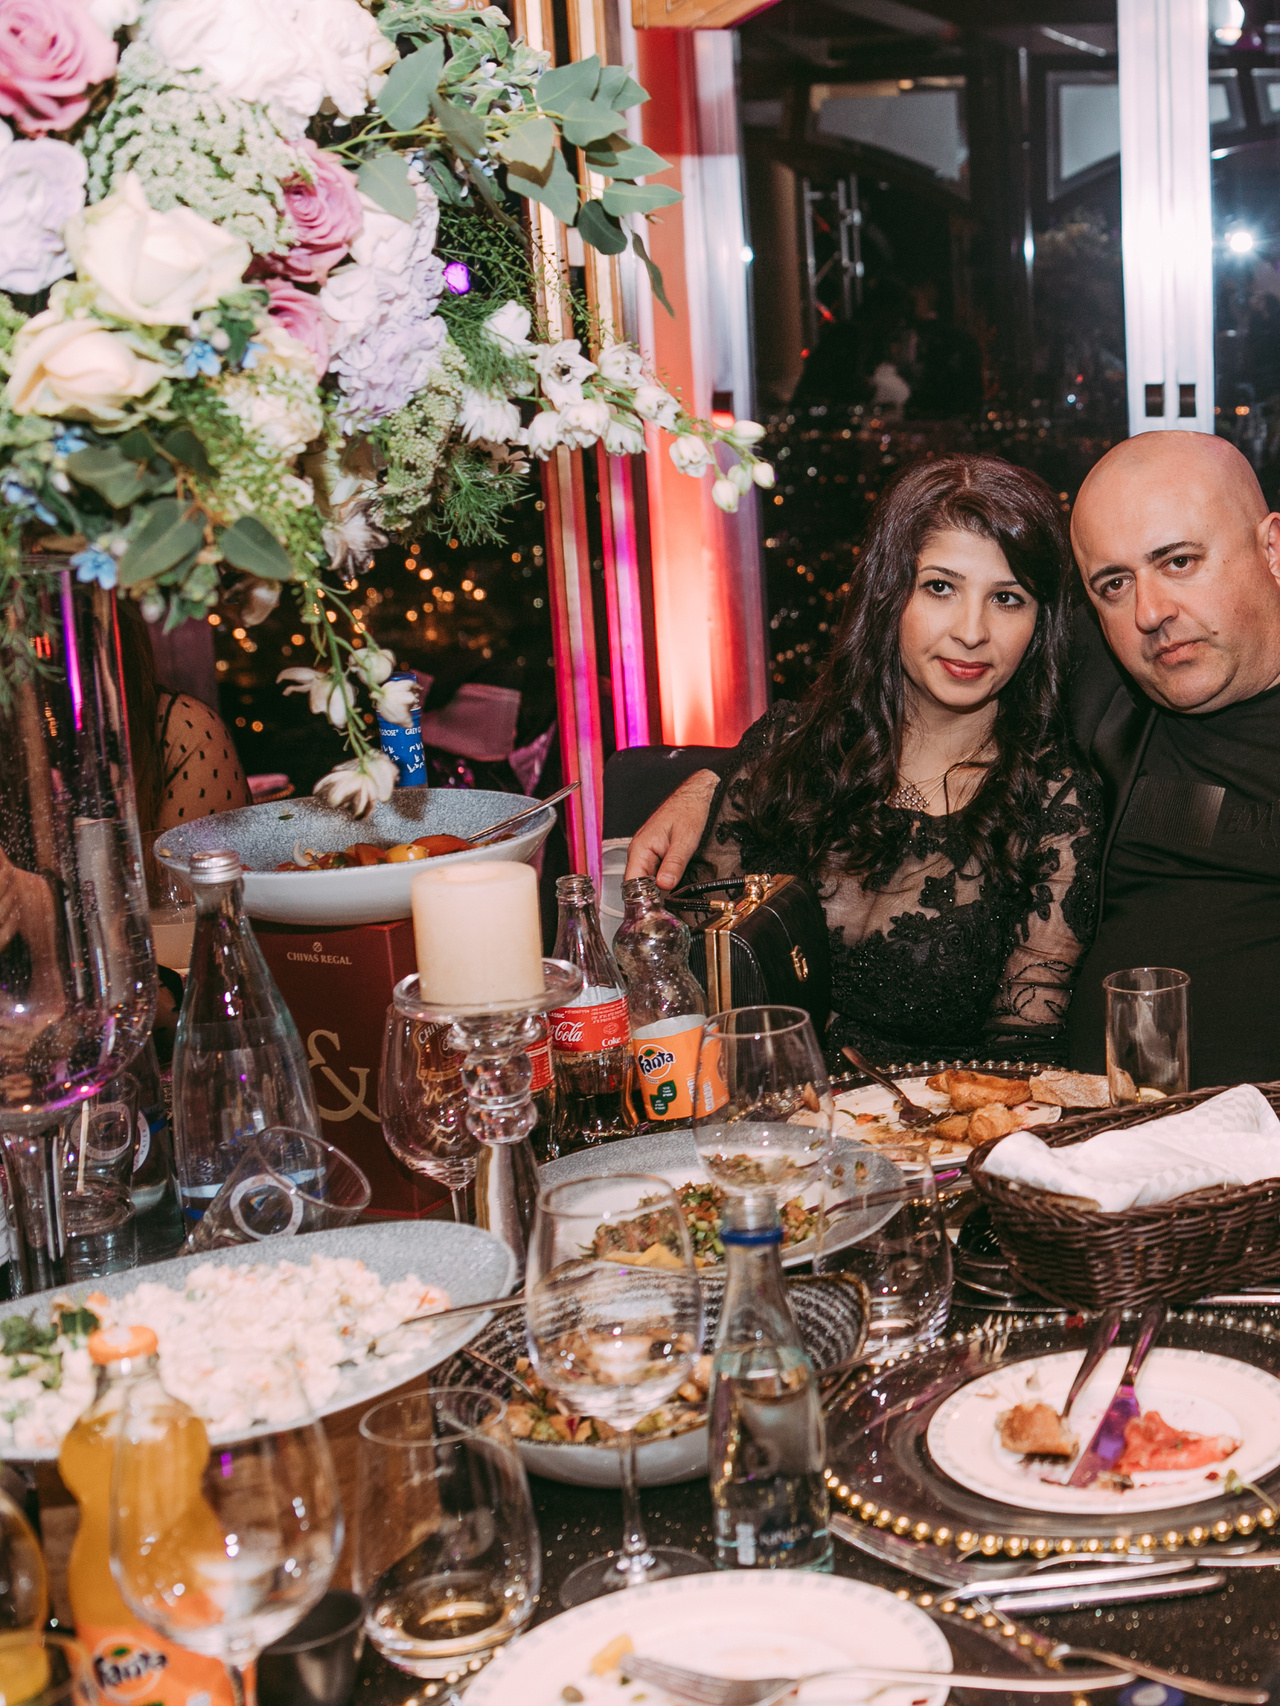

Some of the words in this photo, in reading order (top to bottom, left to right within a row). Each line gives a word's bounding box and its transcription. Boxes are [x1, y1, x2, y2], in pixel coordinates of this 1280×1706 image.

[286, 952, 319, 963] CHIVAS
[320, 954, 353, 965] REGAL
[601, 1036, 622, 1048] Coke
